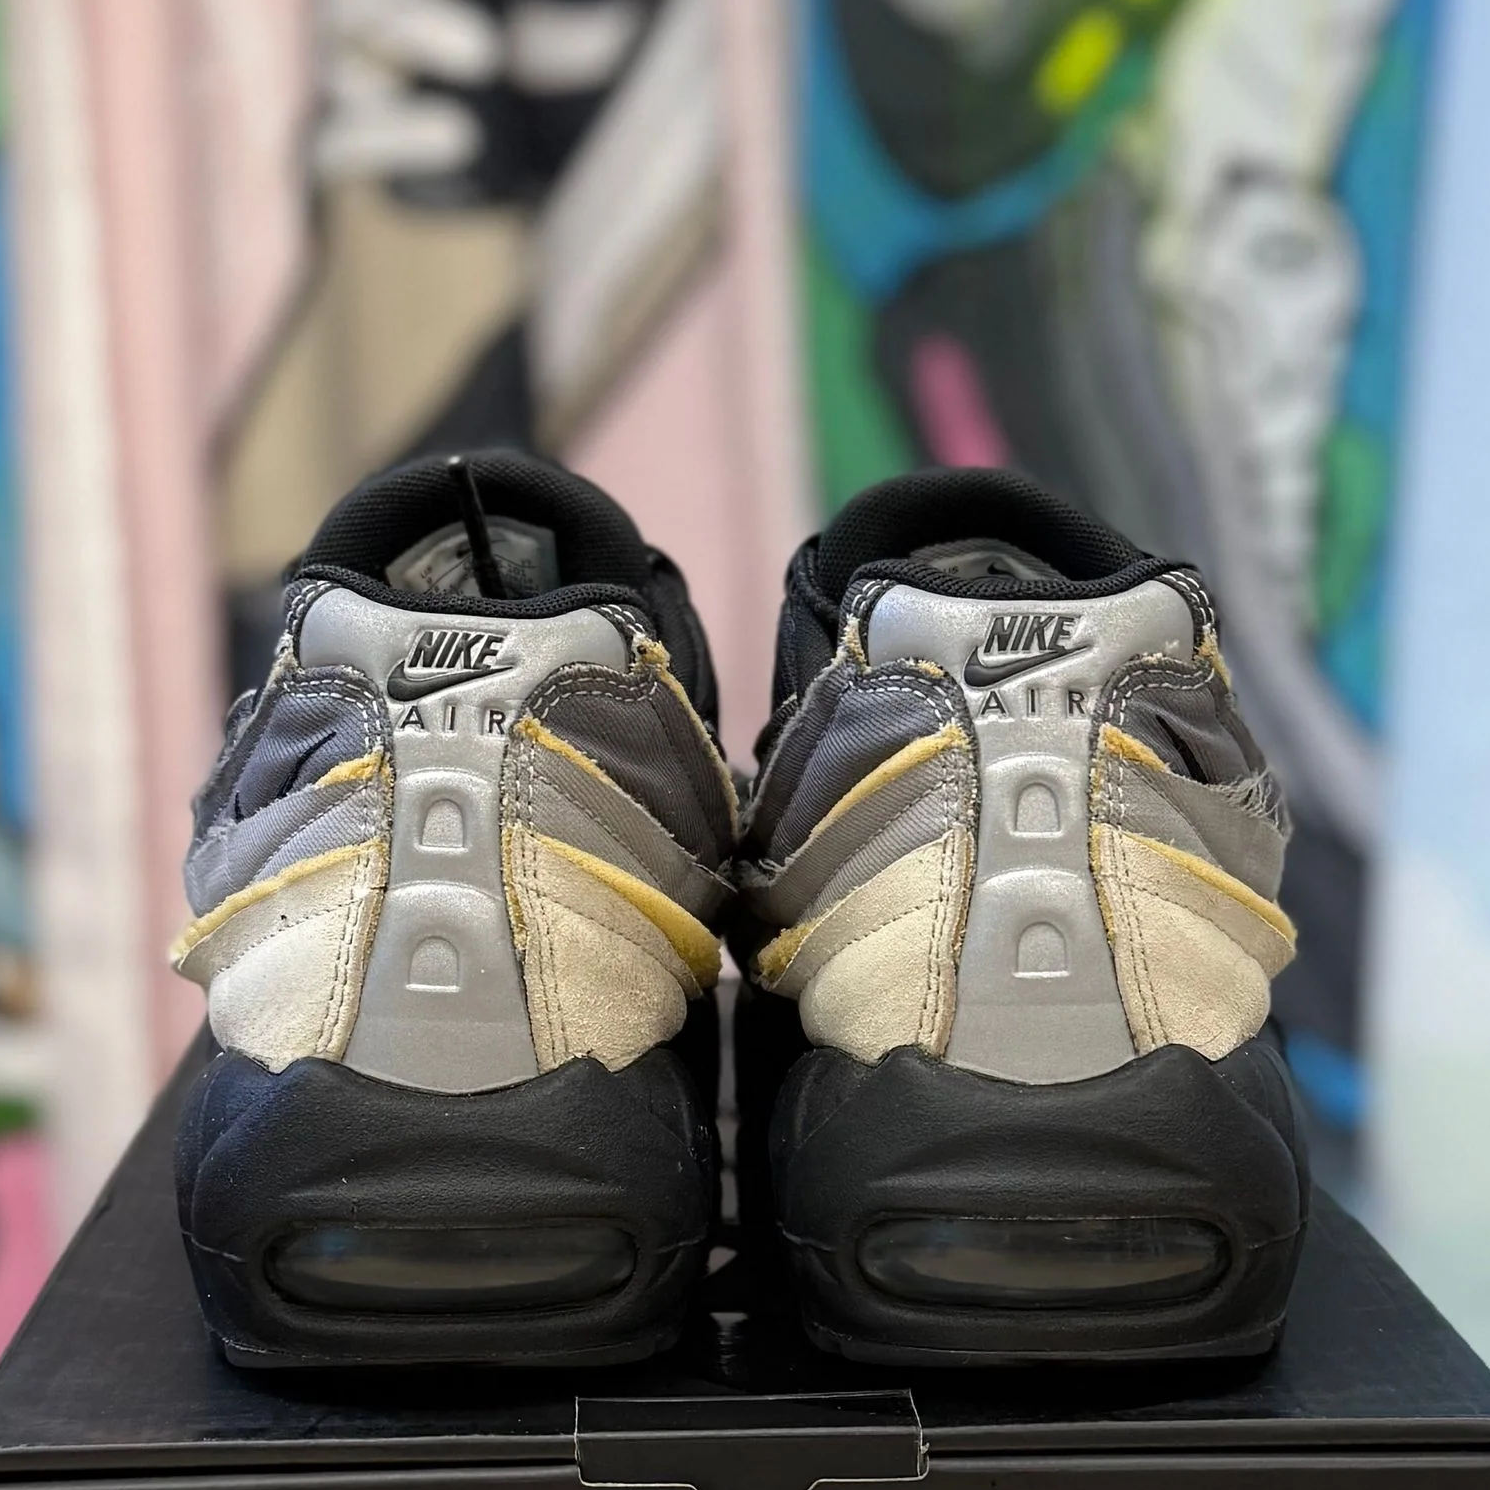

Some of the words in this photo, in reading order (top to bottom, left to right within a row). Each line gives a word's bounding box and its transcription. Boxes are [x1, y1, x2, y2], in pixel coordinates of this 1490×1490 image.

[408, 630, 505, 669] NIKE
[983, 615, 1079, 655] NIKE
[399, 705, 506, 735] AIR
[980, 690, 1086, 716] AIR
